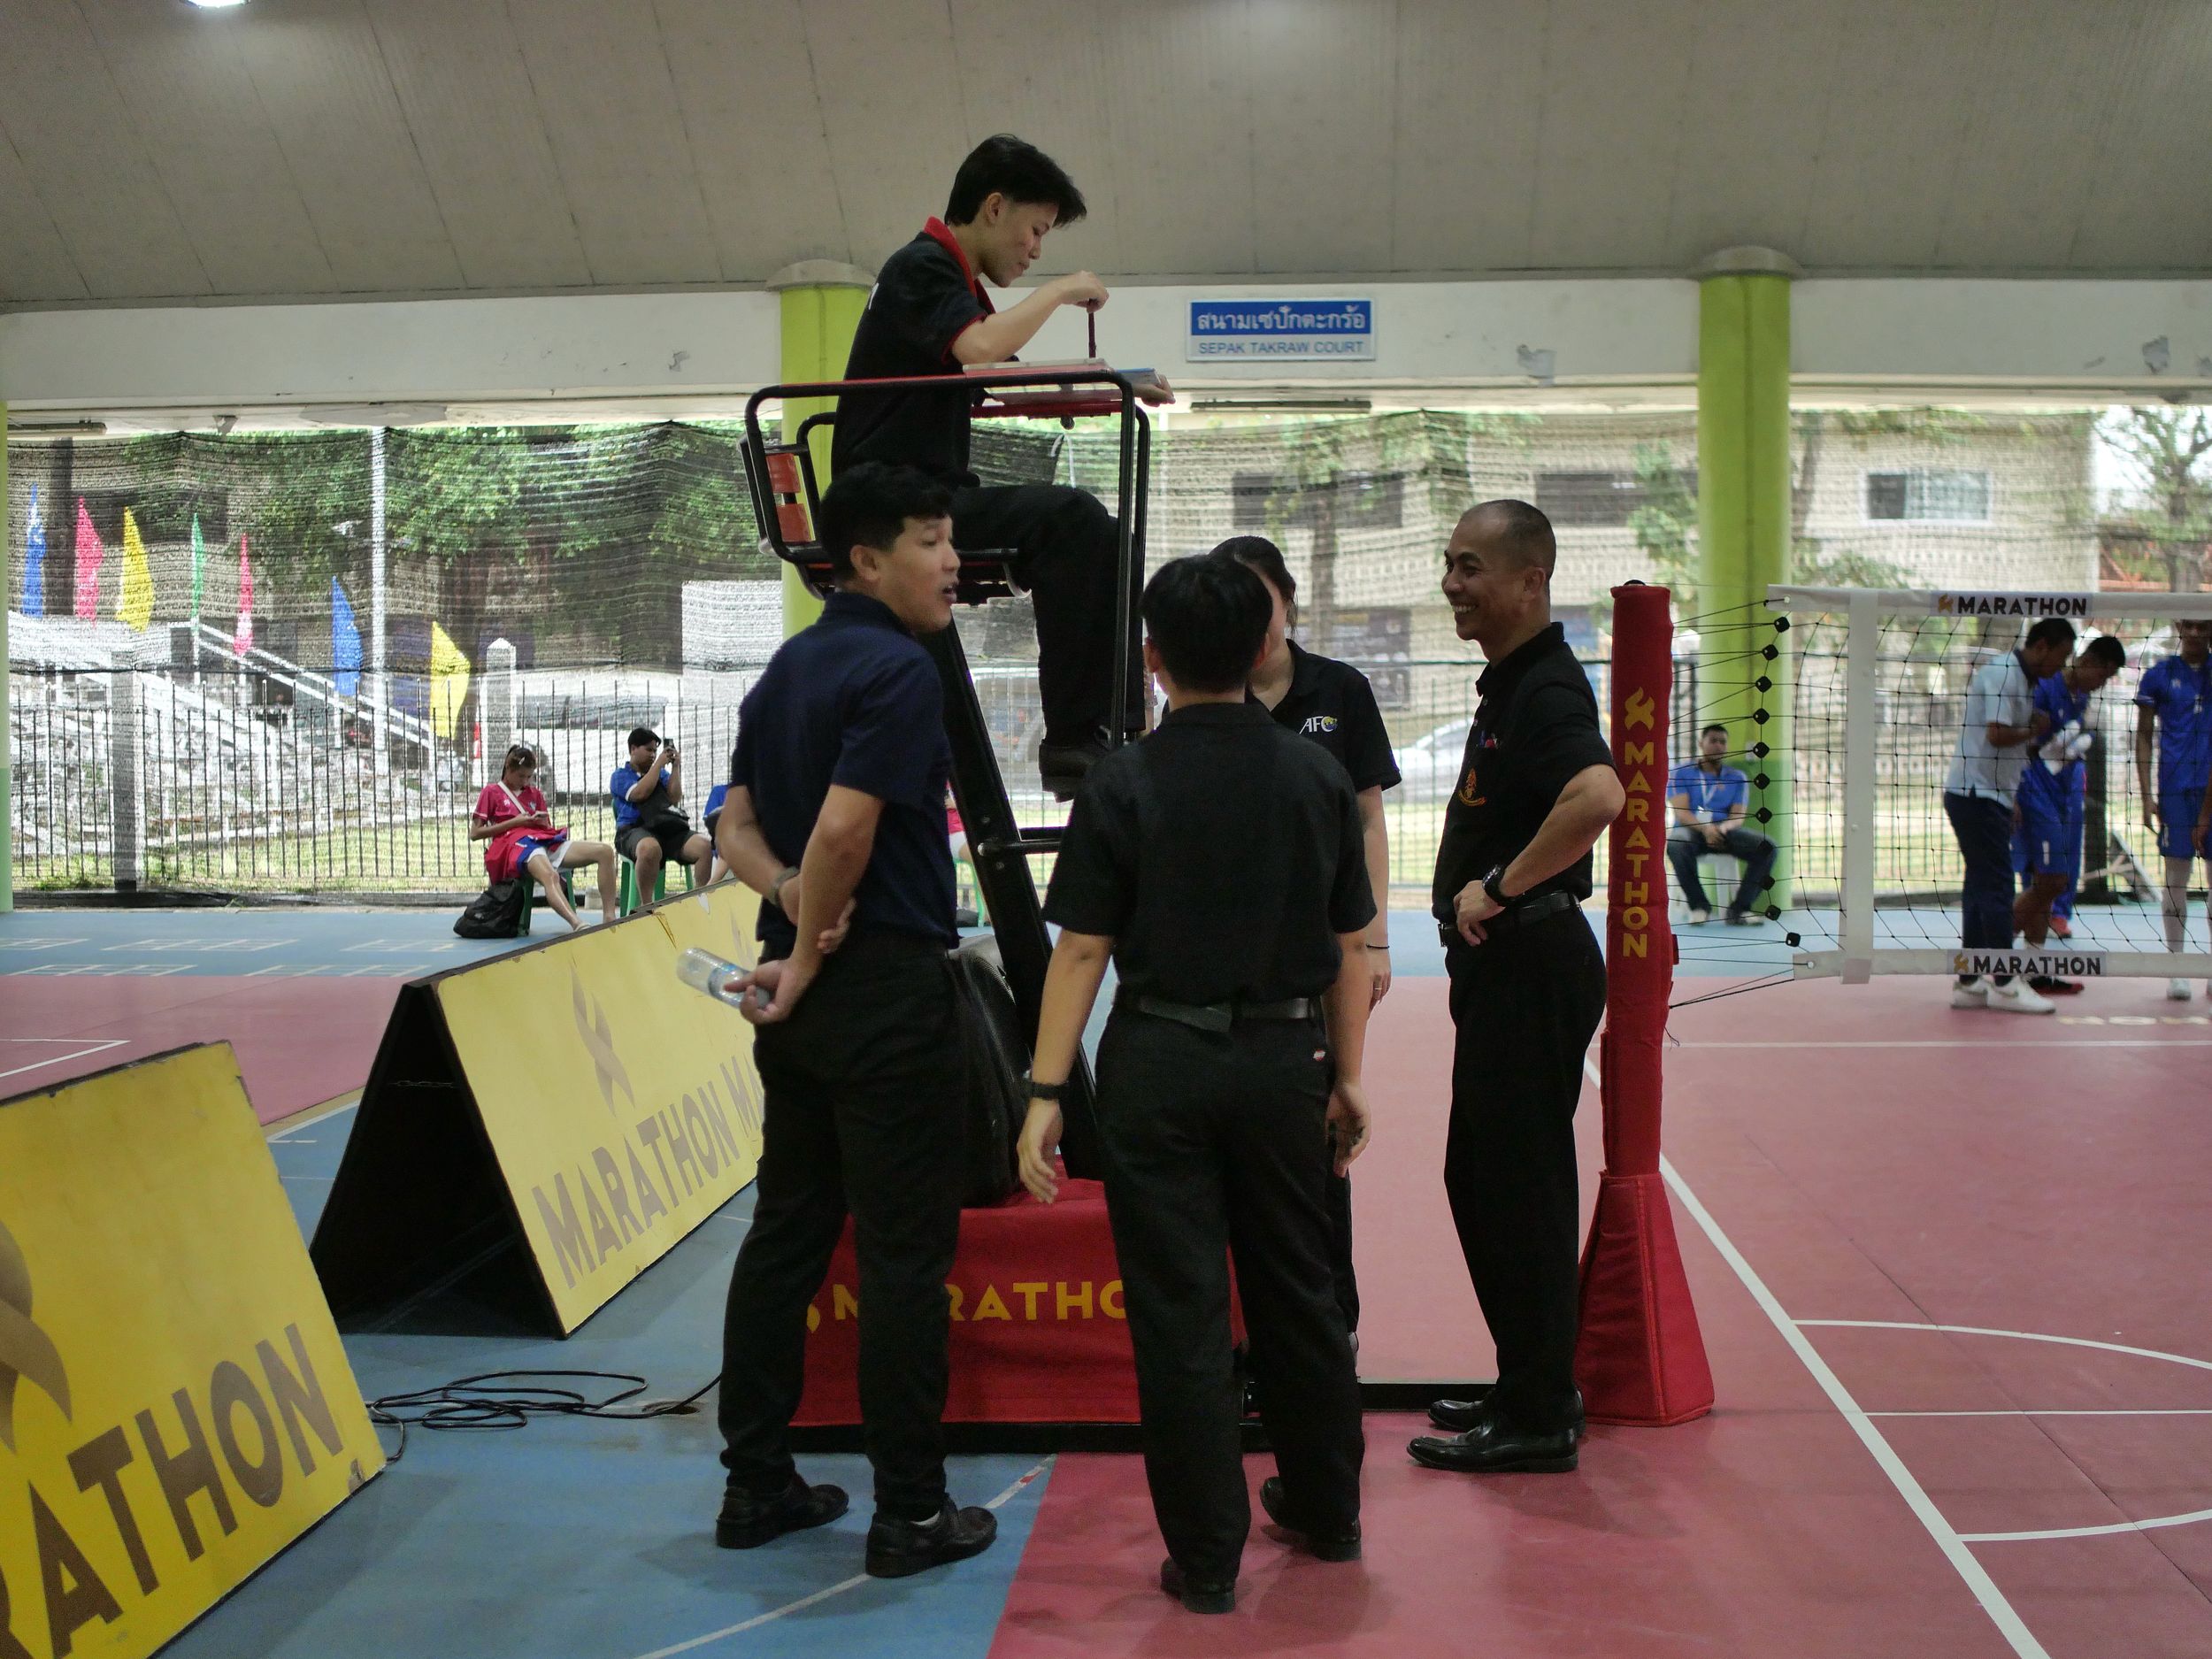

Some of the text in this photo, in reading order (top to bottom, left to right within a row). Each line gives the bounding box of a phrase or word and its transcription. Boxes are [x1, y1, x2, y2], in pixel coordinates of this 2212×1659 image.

[1198, 341, 1364, 354] SEPAK TAKRAW COURT
[1957, 595, 2087, 616] MARATHON
[1299, 716, 1338, 734] AFC
[1622, 741, 1655, 958] MARATHON
[1973, 956, 2101, 975] MARATHON
[531, 1080, 741, 1290] MARATHON
